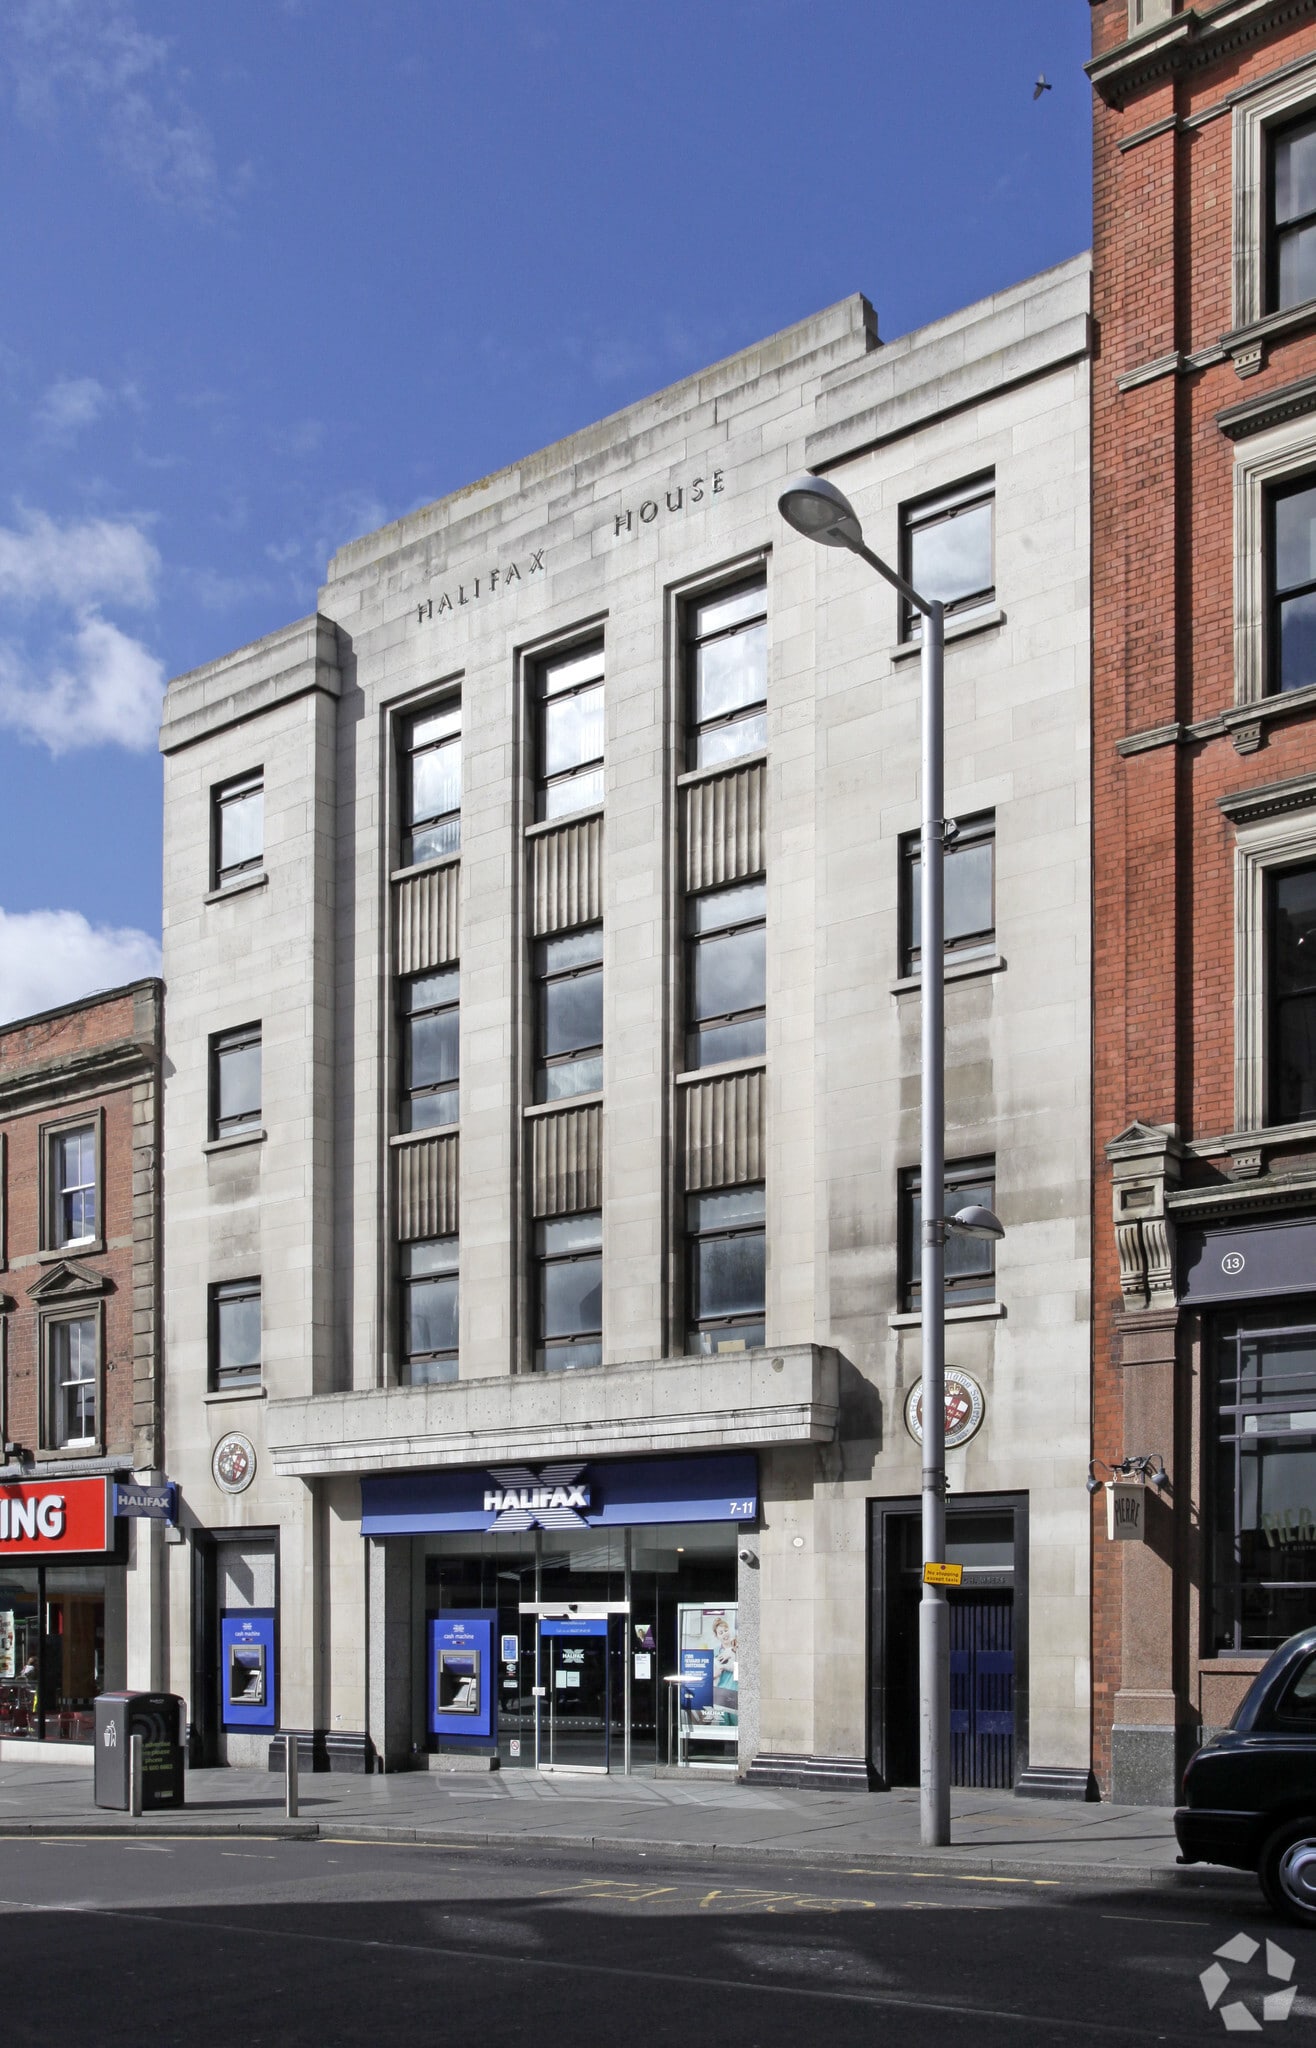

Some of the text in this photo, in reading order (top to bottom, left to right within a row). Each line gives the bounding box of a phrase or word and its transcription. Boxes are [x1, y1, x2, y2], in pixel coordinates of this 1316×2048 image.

[417, 469, 725, 623] HALIFAX HOUSE
[1226, 1258, 1240, 1269] 13
[118, 1495, 170, 1508] HALIFAX
[484, 1485, 588, 1511] HALIFAX
[726, 1502, 753, 1515] 7-11
[0, 1494, 62, 1538] ING
[1114, 1498, 1140, 1527] PIERRE
